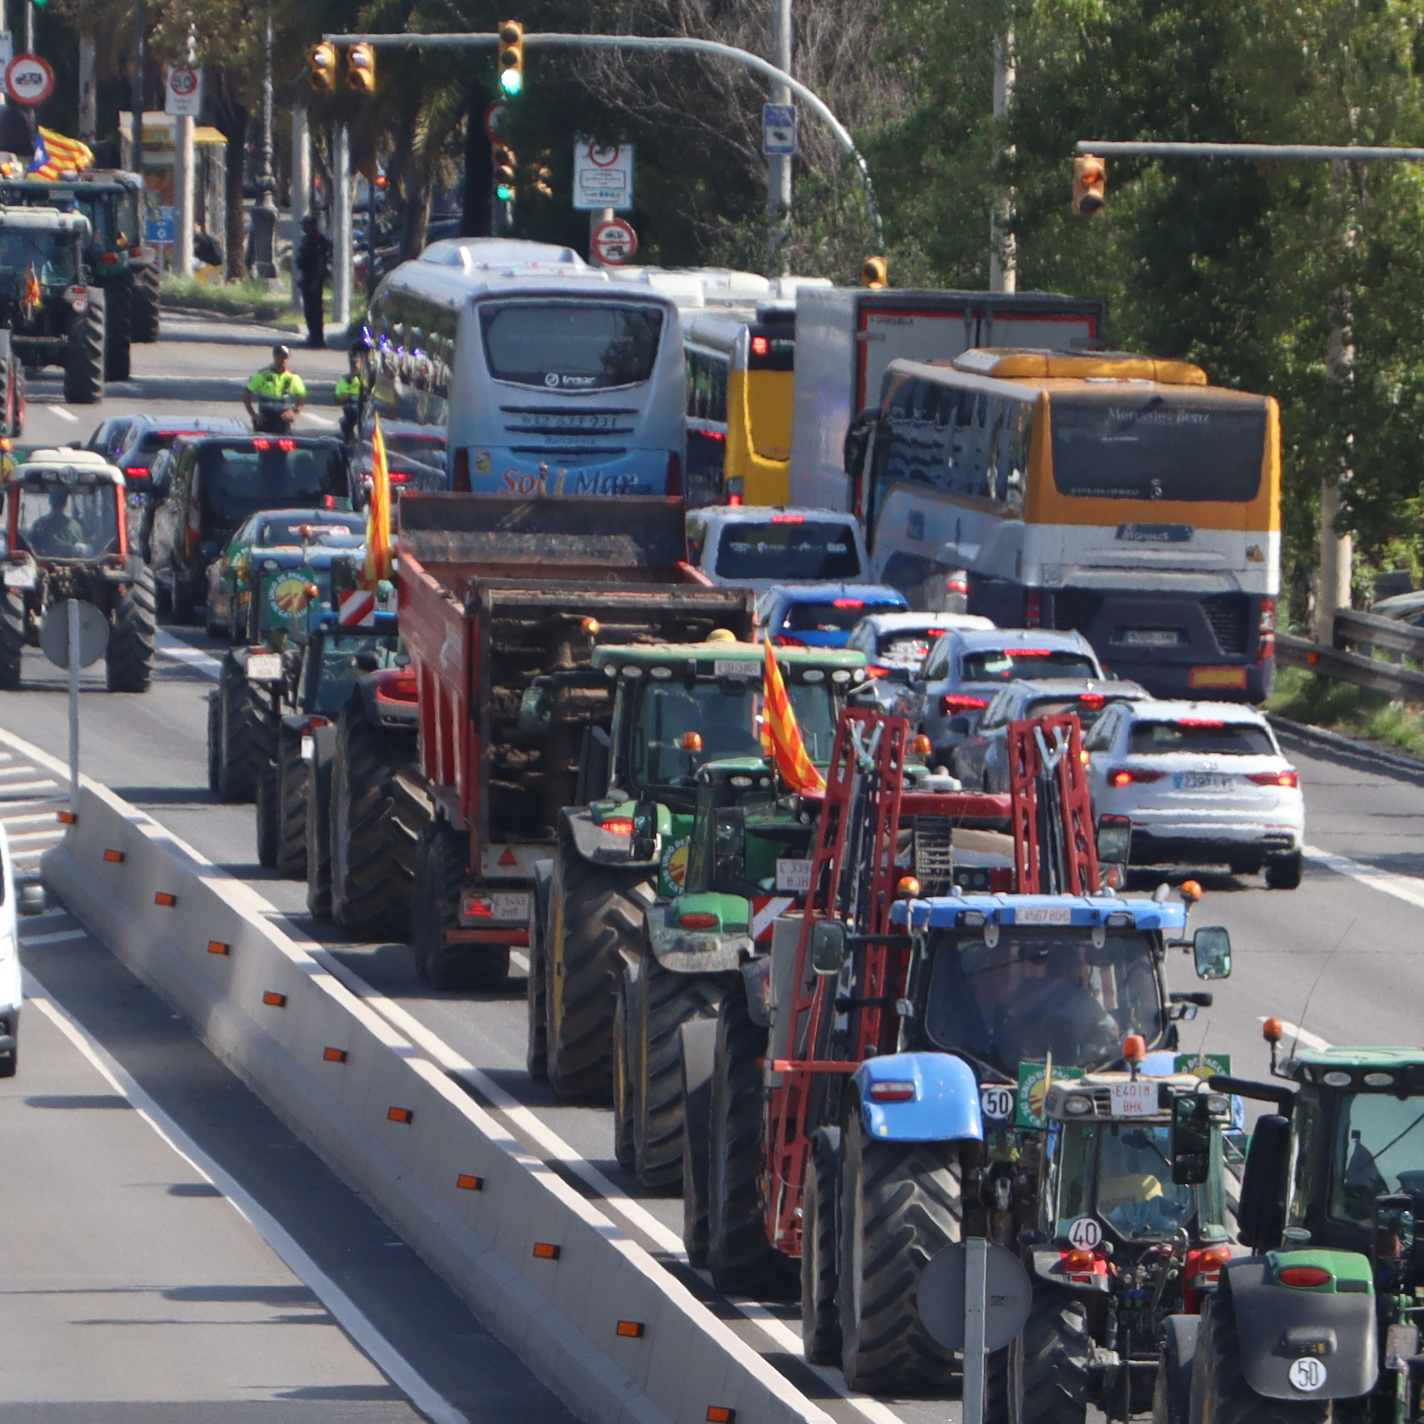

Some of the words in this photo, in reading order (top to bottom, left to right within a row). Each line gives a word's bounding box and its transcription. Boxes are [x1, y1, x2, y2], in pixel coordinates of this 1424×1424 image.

[986, 1091, 1009, 1114] 50
[1073, 1222, 1098, 1246] 40
[1297, 1360, 1320, 1387] 50
